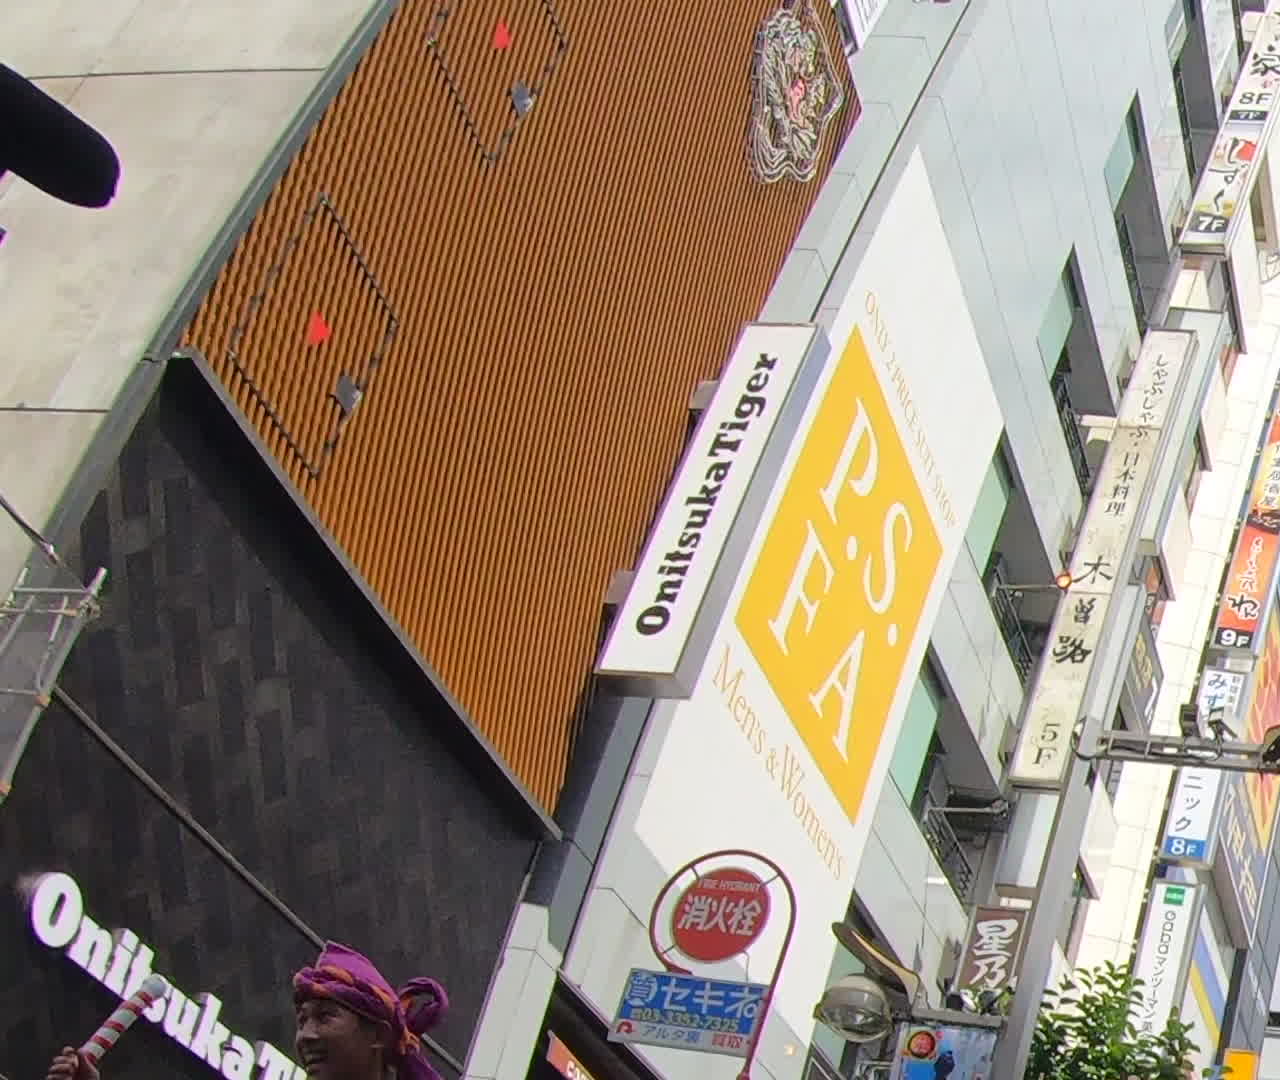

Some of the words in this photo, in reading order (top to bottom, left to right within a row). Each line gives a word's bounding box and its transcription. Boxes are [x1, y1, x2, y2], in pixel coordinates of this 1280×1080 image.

[1197, 216, 1226, 233] 7F
[1219, 631, 1251, 647] 9F
[1170, 838, 1197, 856] 8F
[678, 894, 763, 937] 消火栓
